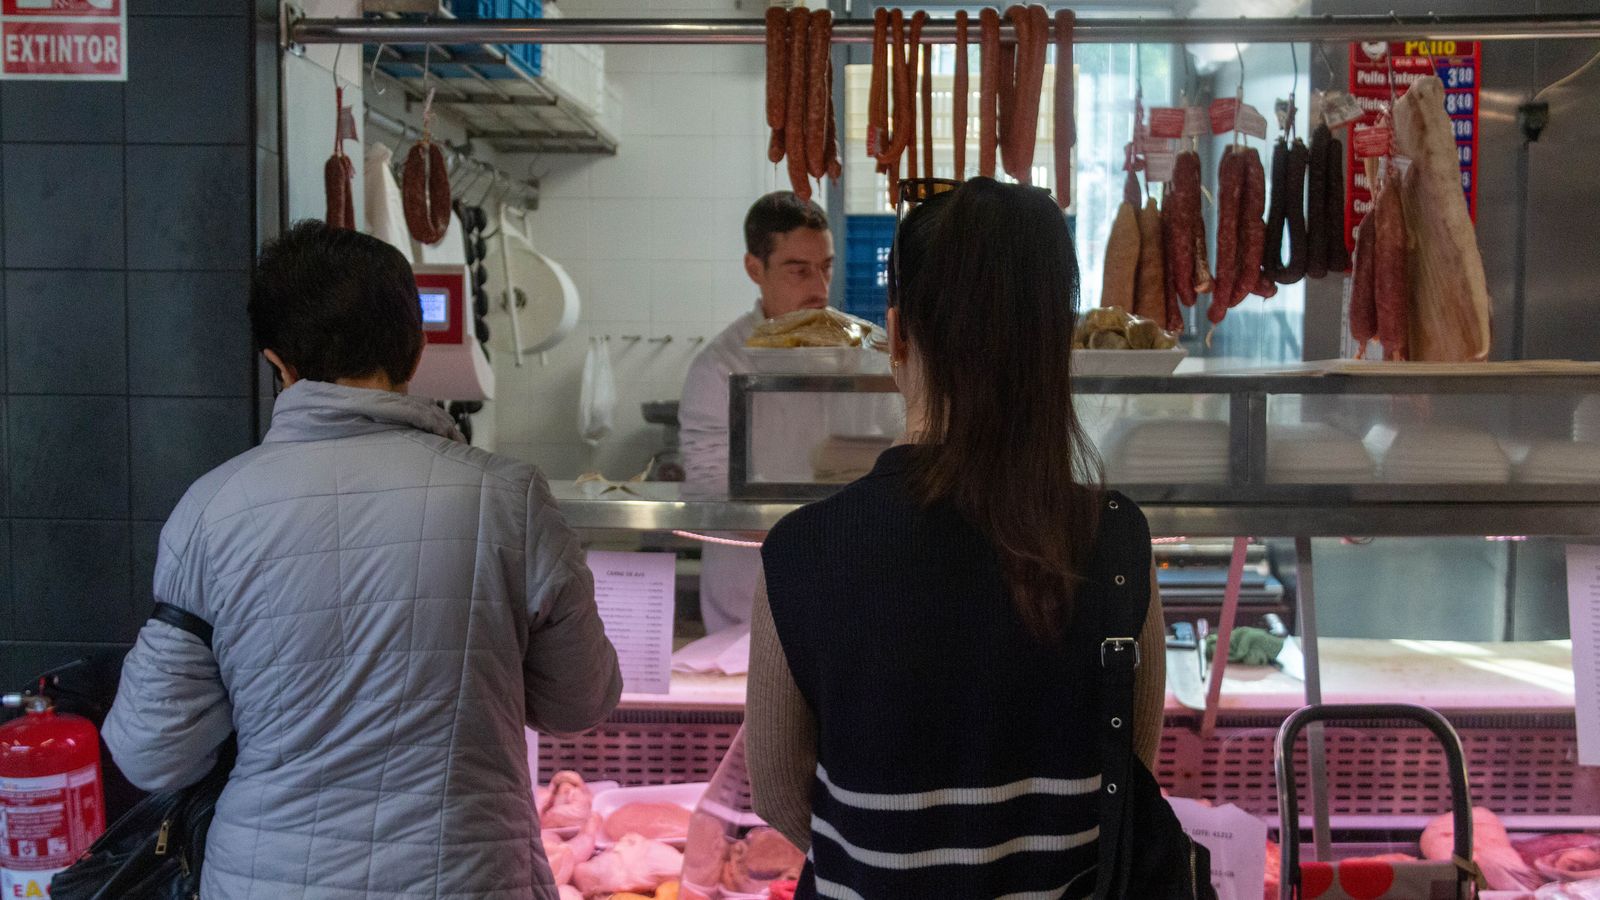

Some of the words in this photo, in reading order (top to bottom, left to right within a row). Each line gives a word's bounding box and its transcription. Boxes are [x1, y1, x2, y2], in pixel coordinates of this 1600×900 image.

[6, 34, 119, 64] EXTINTOR
[1405, 40, 1456, 57] Pollo
[1357, 70, 1387, 86] Pollo
